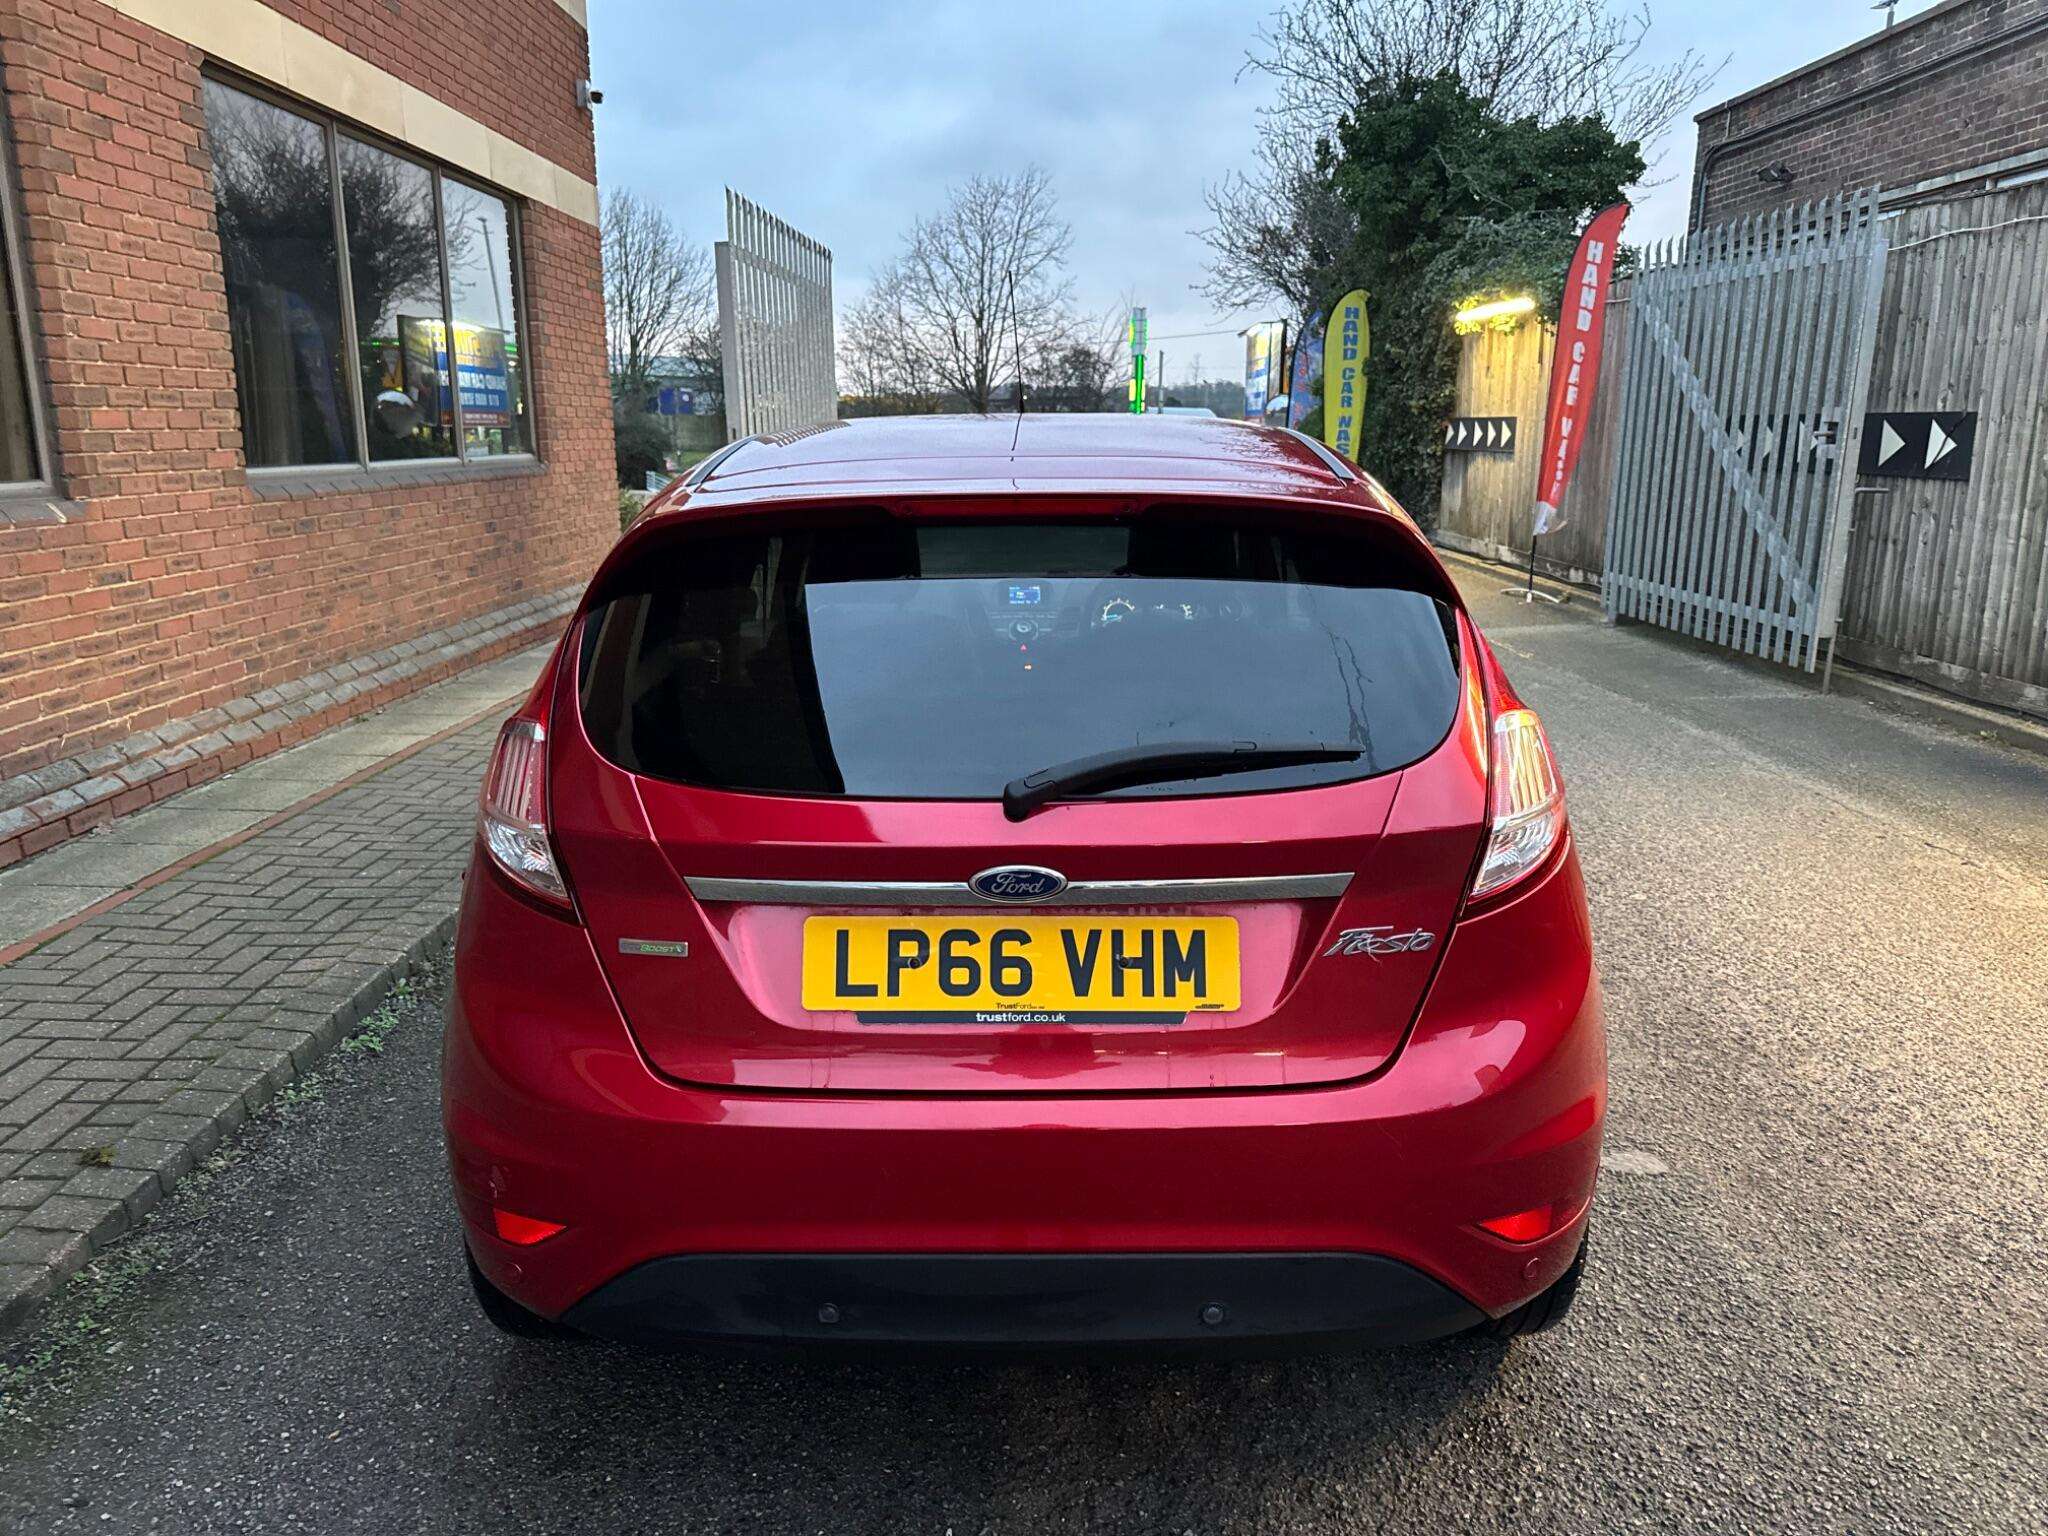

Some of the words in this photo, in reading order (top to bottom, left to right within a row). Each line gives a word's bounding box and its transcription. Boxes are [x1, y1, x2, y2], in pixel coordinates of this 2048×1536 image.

[1576, 240, 1604, 332] HAND
[1342, 306, 1360, 361] HAND
[1341, 367, 1356, 408] CAR
[1336, 415, 1353, 456] WAS
[991, 872, 1045, 894] Ford
[1323, 925, 1435, 957] Fiesta
[834, 928, 1033, 998] LP66
[1060, 928, 1208, 998] VHM
[976, 1011, 1066, 1022] trustford.co.uk
